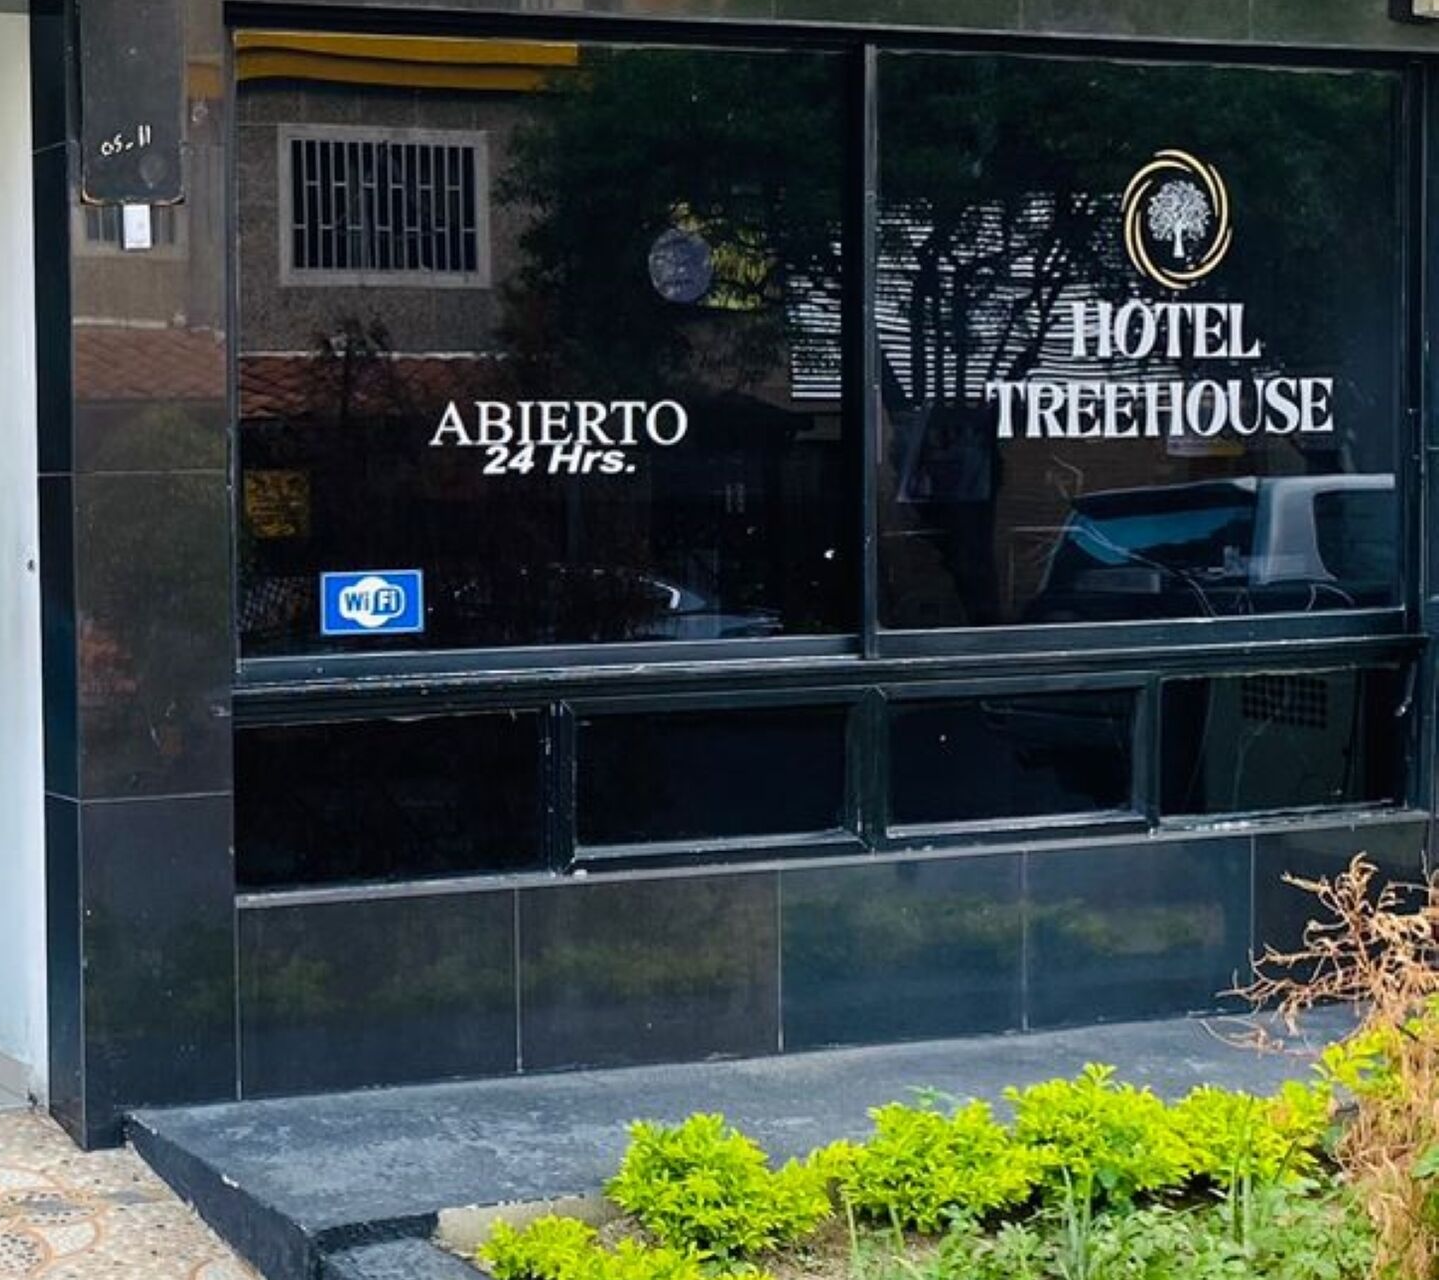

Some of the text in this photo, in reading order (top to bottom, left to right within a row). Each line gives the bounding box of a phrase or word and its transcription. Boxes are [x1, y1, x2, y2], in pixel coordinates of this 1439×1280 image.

[1070, 299, 1264, 360] HOTEL
[429, 400, 689, 446] ABIERTO
[482, 443, 637, 475] 24 Hrs.
